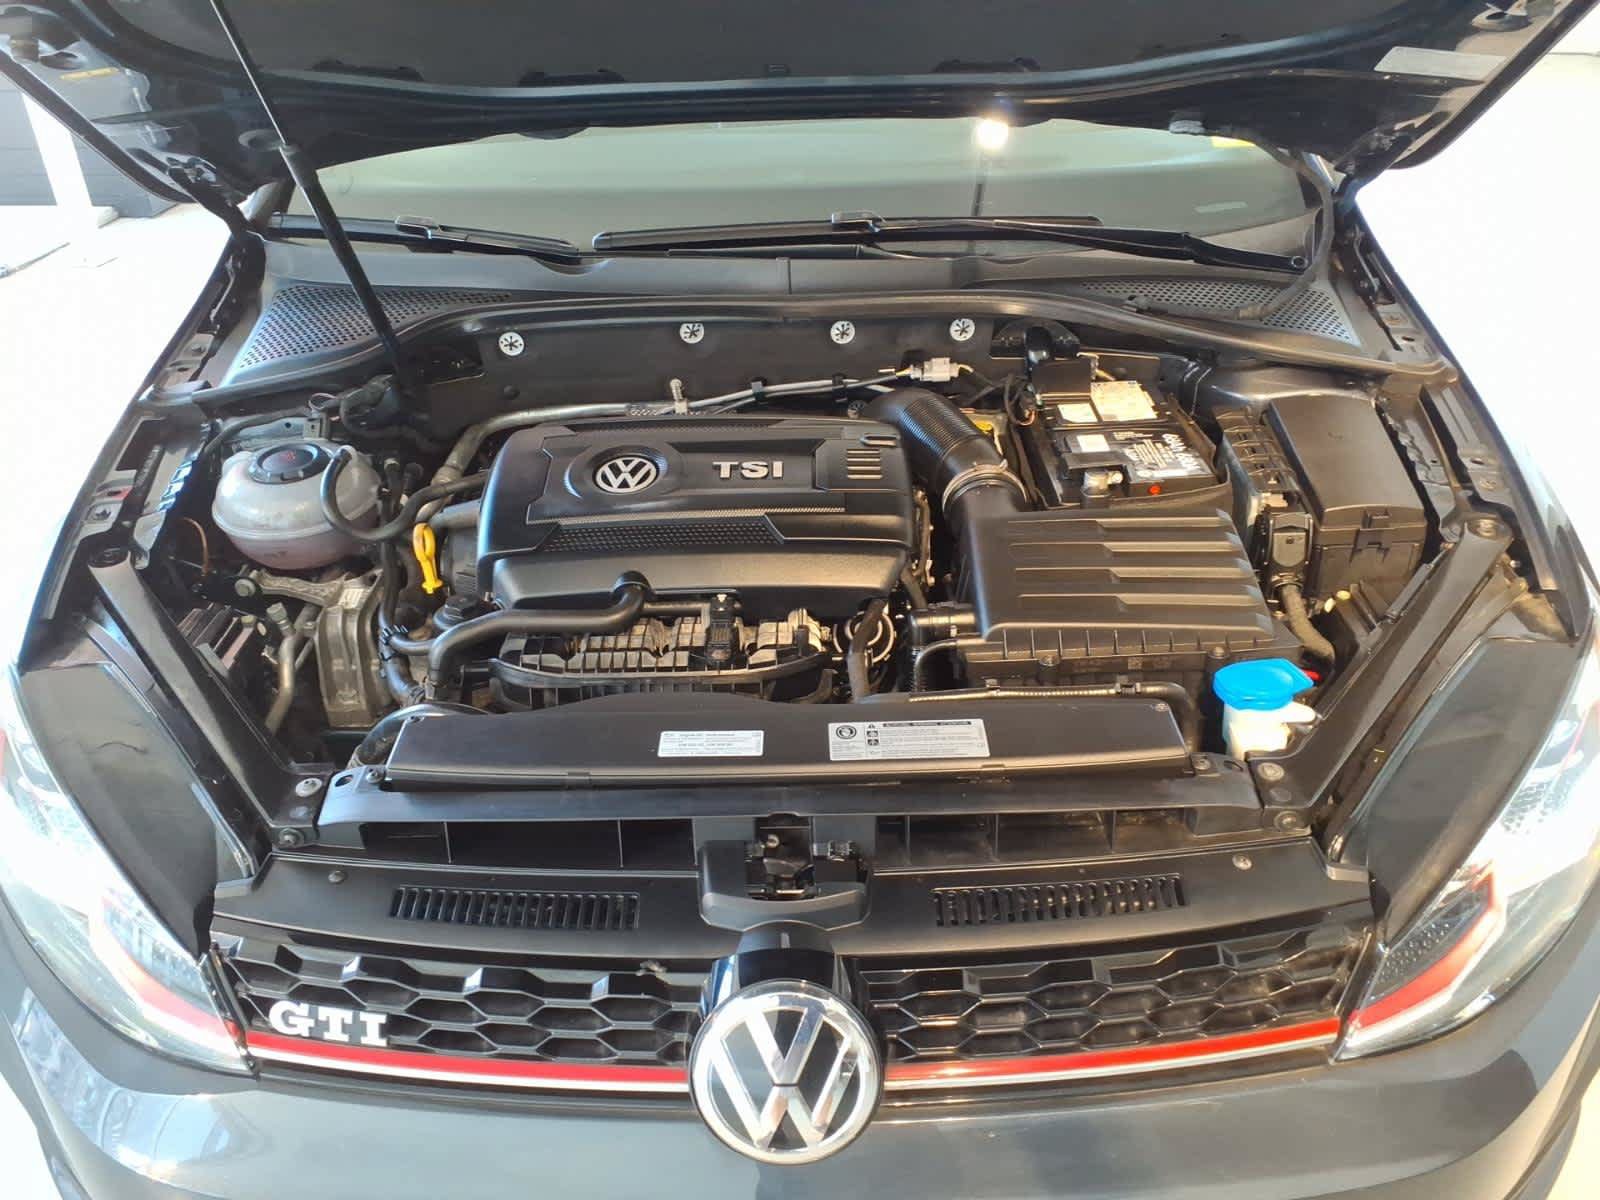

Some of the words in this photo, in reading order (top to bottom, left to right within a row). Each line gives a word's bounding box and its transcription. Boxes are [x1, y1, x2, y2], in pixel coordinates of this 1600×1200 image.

[595, 455, 657, 493] VW
[713, 460, 783, 479] TSI
[268, 1000, 388, 1047] GTI
[694, 990, 878, 1162] VW
